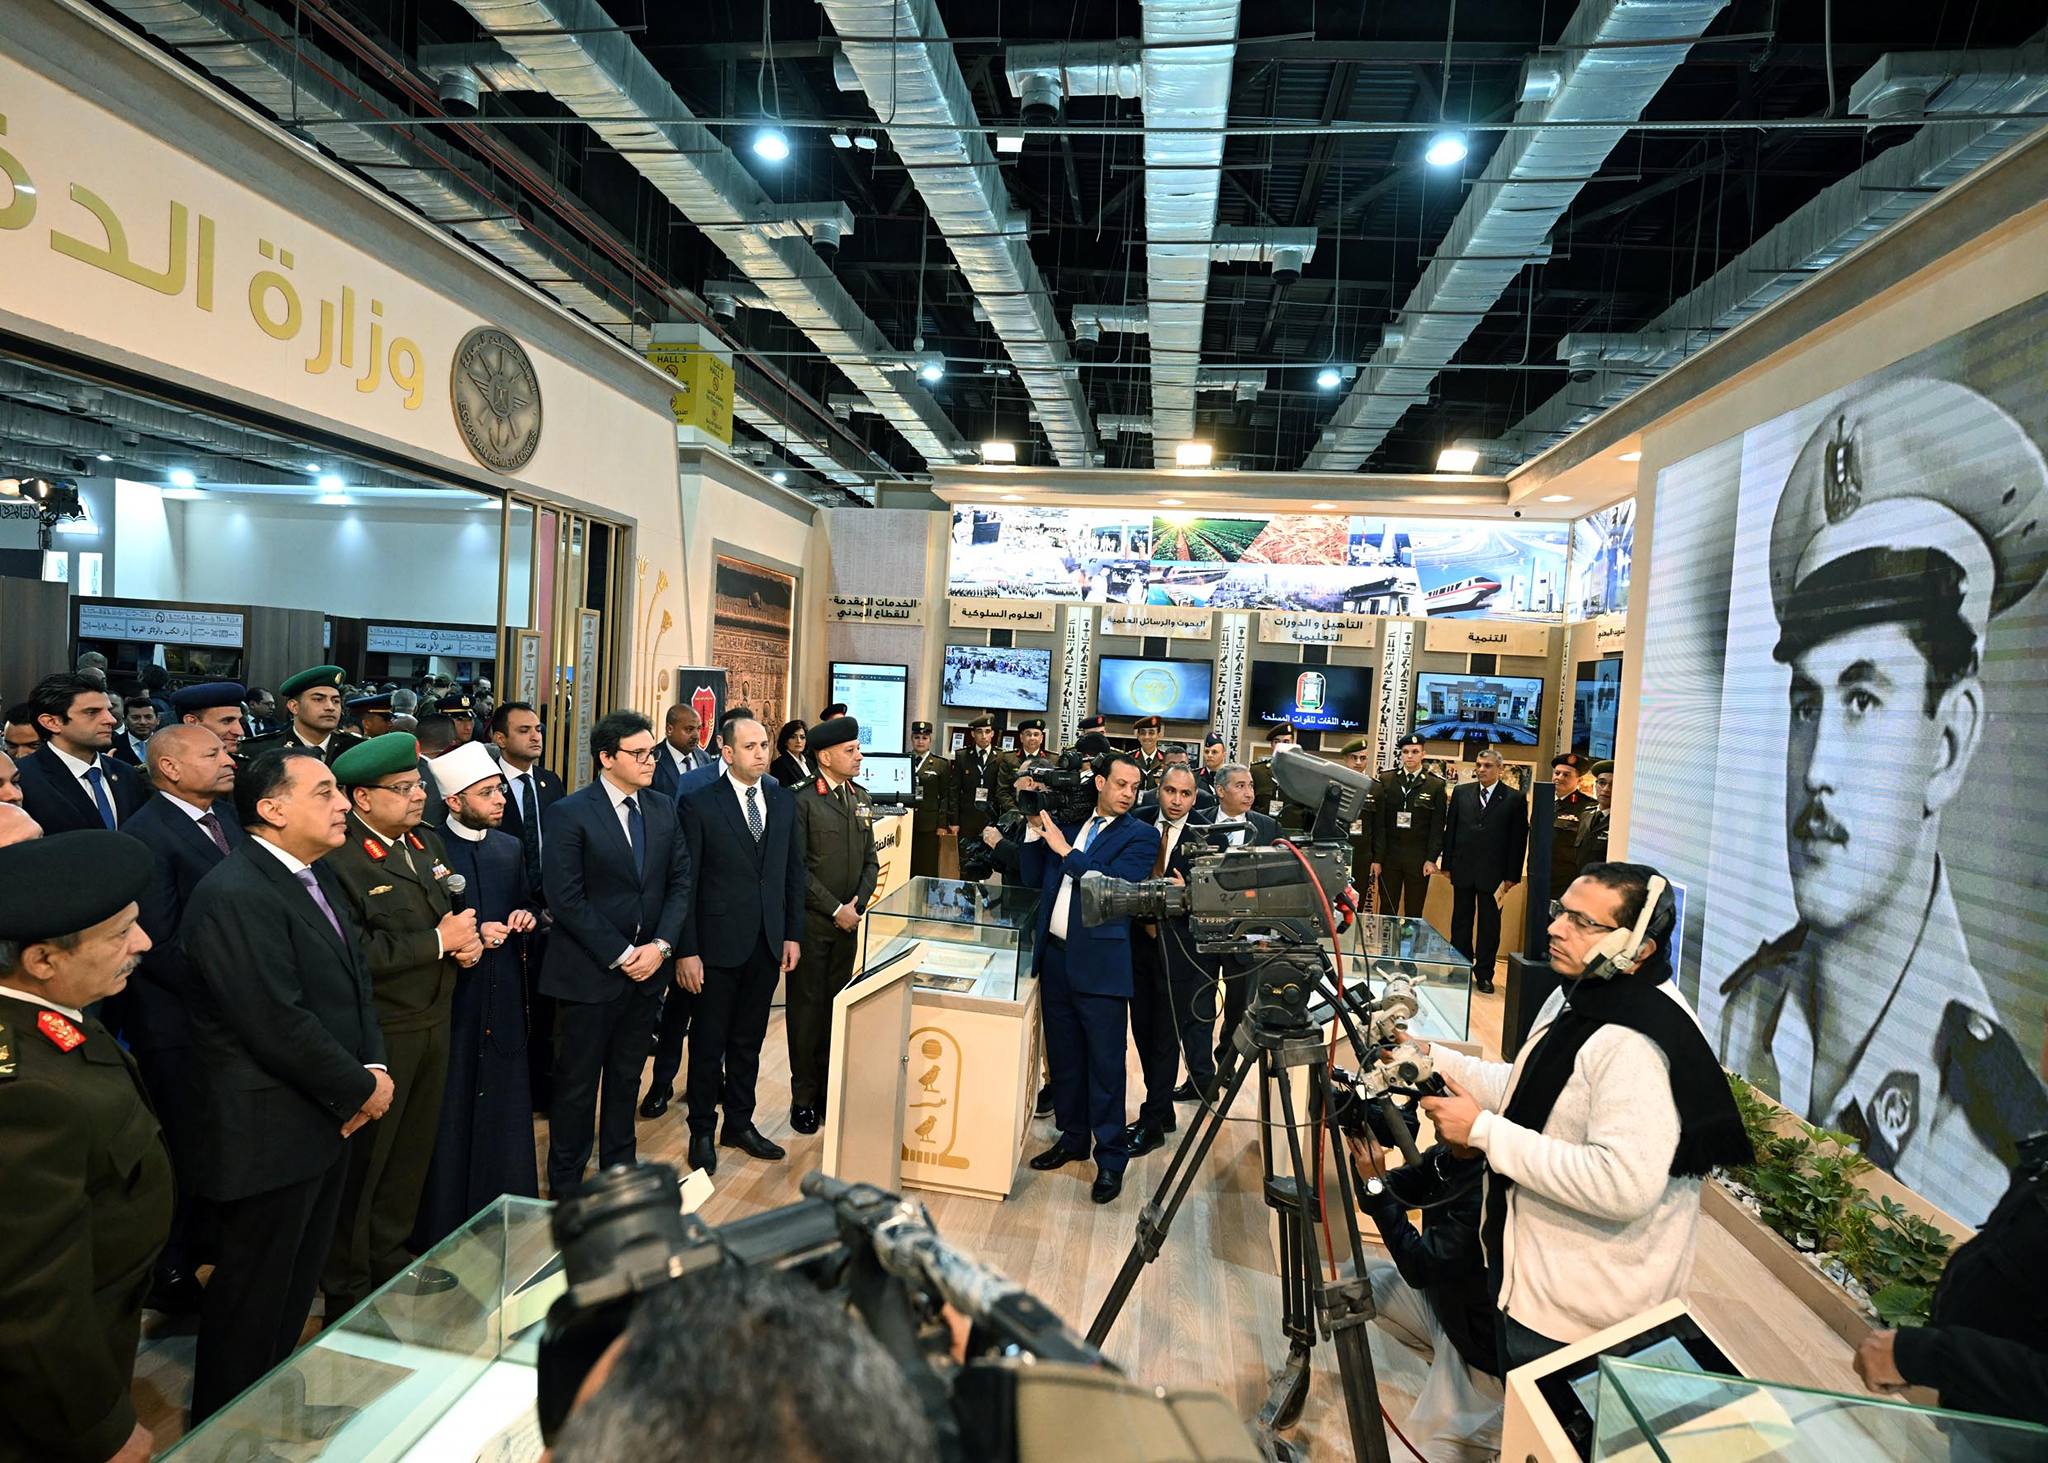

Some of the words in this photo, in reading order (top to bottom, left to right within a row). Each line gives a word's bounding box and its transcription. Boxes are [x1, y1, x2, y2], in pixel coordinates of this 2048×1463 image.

[248, 239, 425, 410] وزارة
[459, 401, 488, 459] EGYPTIAN
[517, 430, 537, 464] FORCES
[833, 595, 873, 606] المقدمة
[875, 598, 917, 608] الخدمات
[837, 608, 872, 620] المدني
[874, 609, 909, 619] للقطاع
[961, 608, 1007, 619] السلوكية
[1008, 610, 1042, 620] العلوم
[1140, 617, 1175, 628] والرسائل
[1274, 617, 1311, 628] الدورات
[1314, 621, 1320, 630] و
[1322, 618, 1363, 630] التأهيل
[1292, 631, 1343, 643] التعليمية
[1467, 632, 1508, 644] التنمية
[1261, 711, 1290, 722] المسلحة
[1292, 715, 1316, 725] للقوات
[1317, 716, 1339, 725] اللغات
[1341, 719, 1359, 728] معهد
